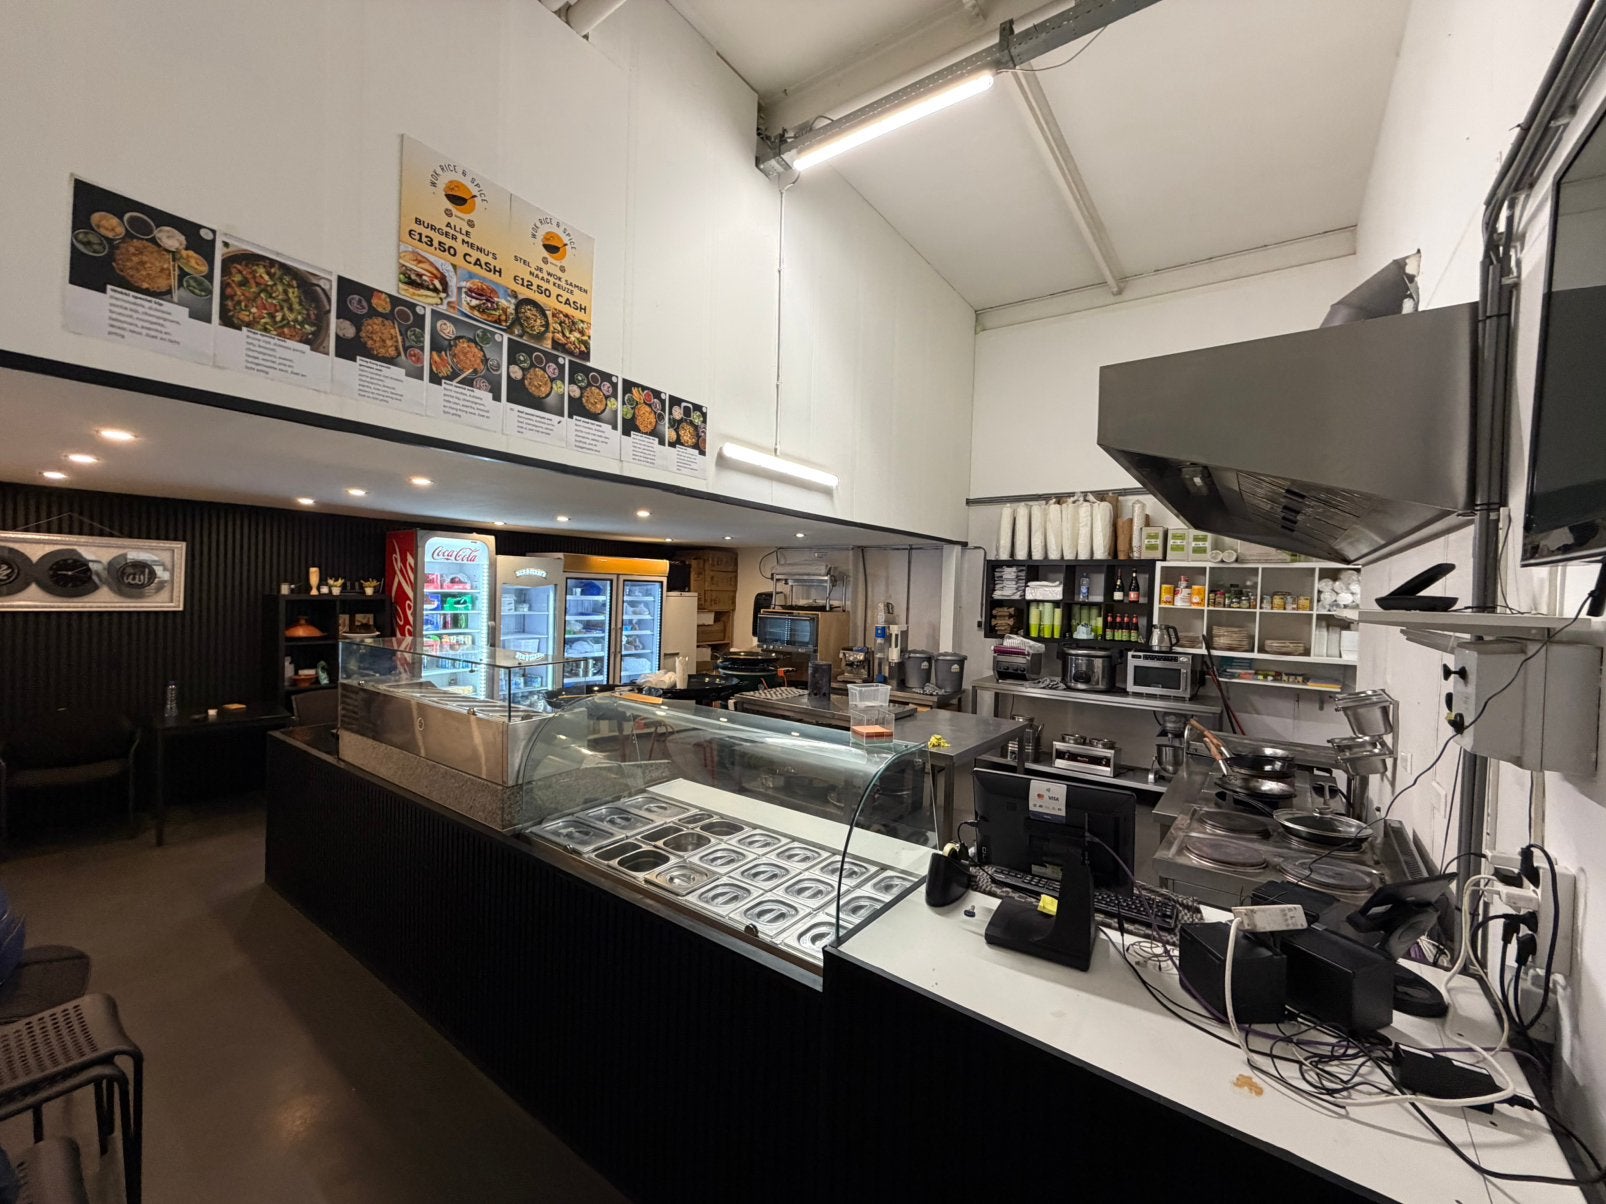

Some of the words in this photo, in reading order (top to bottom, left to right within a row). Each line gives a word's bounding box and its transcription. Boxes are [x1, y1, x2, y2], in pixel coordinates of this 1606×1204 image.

[430, 169, 441, 188] WOK
[439, 163, 458, 174] RICE
[470, 177, 489, 204] SPICE
[414, 216, 458, 242] BURGER
[461, 238, 498, 260] MENU'S
[445, 221, 472, 239] ALLE
[408, 228, 458, 258] €13,50
[463, 252, 503, 278] CASH
[513, 254, 532, 269] STEL
[534, 265, 544, 274] JE
[546, 270, 563, 283] WOK
[564, 279, 589, 295] SAMEN
[513, 274, 552, 299] €12,50
[555, 293, 588, 315] CASH
[529, 270, 551, 285] NAAR
[552, 281, 575, 296] KEUZE
